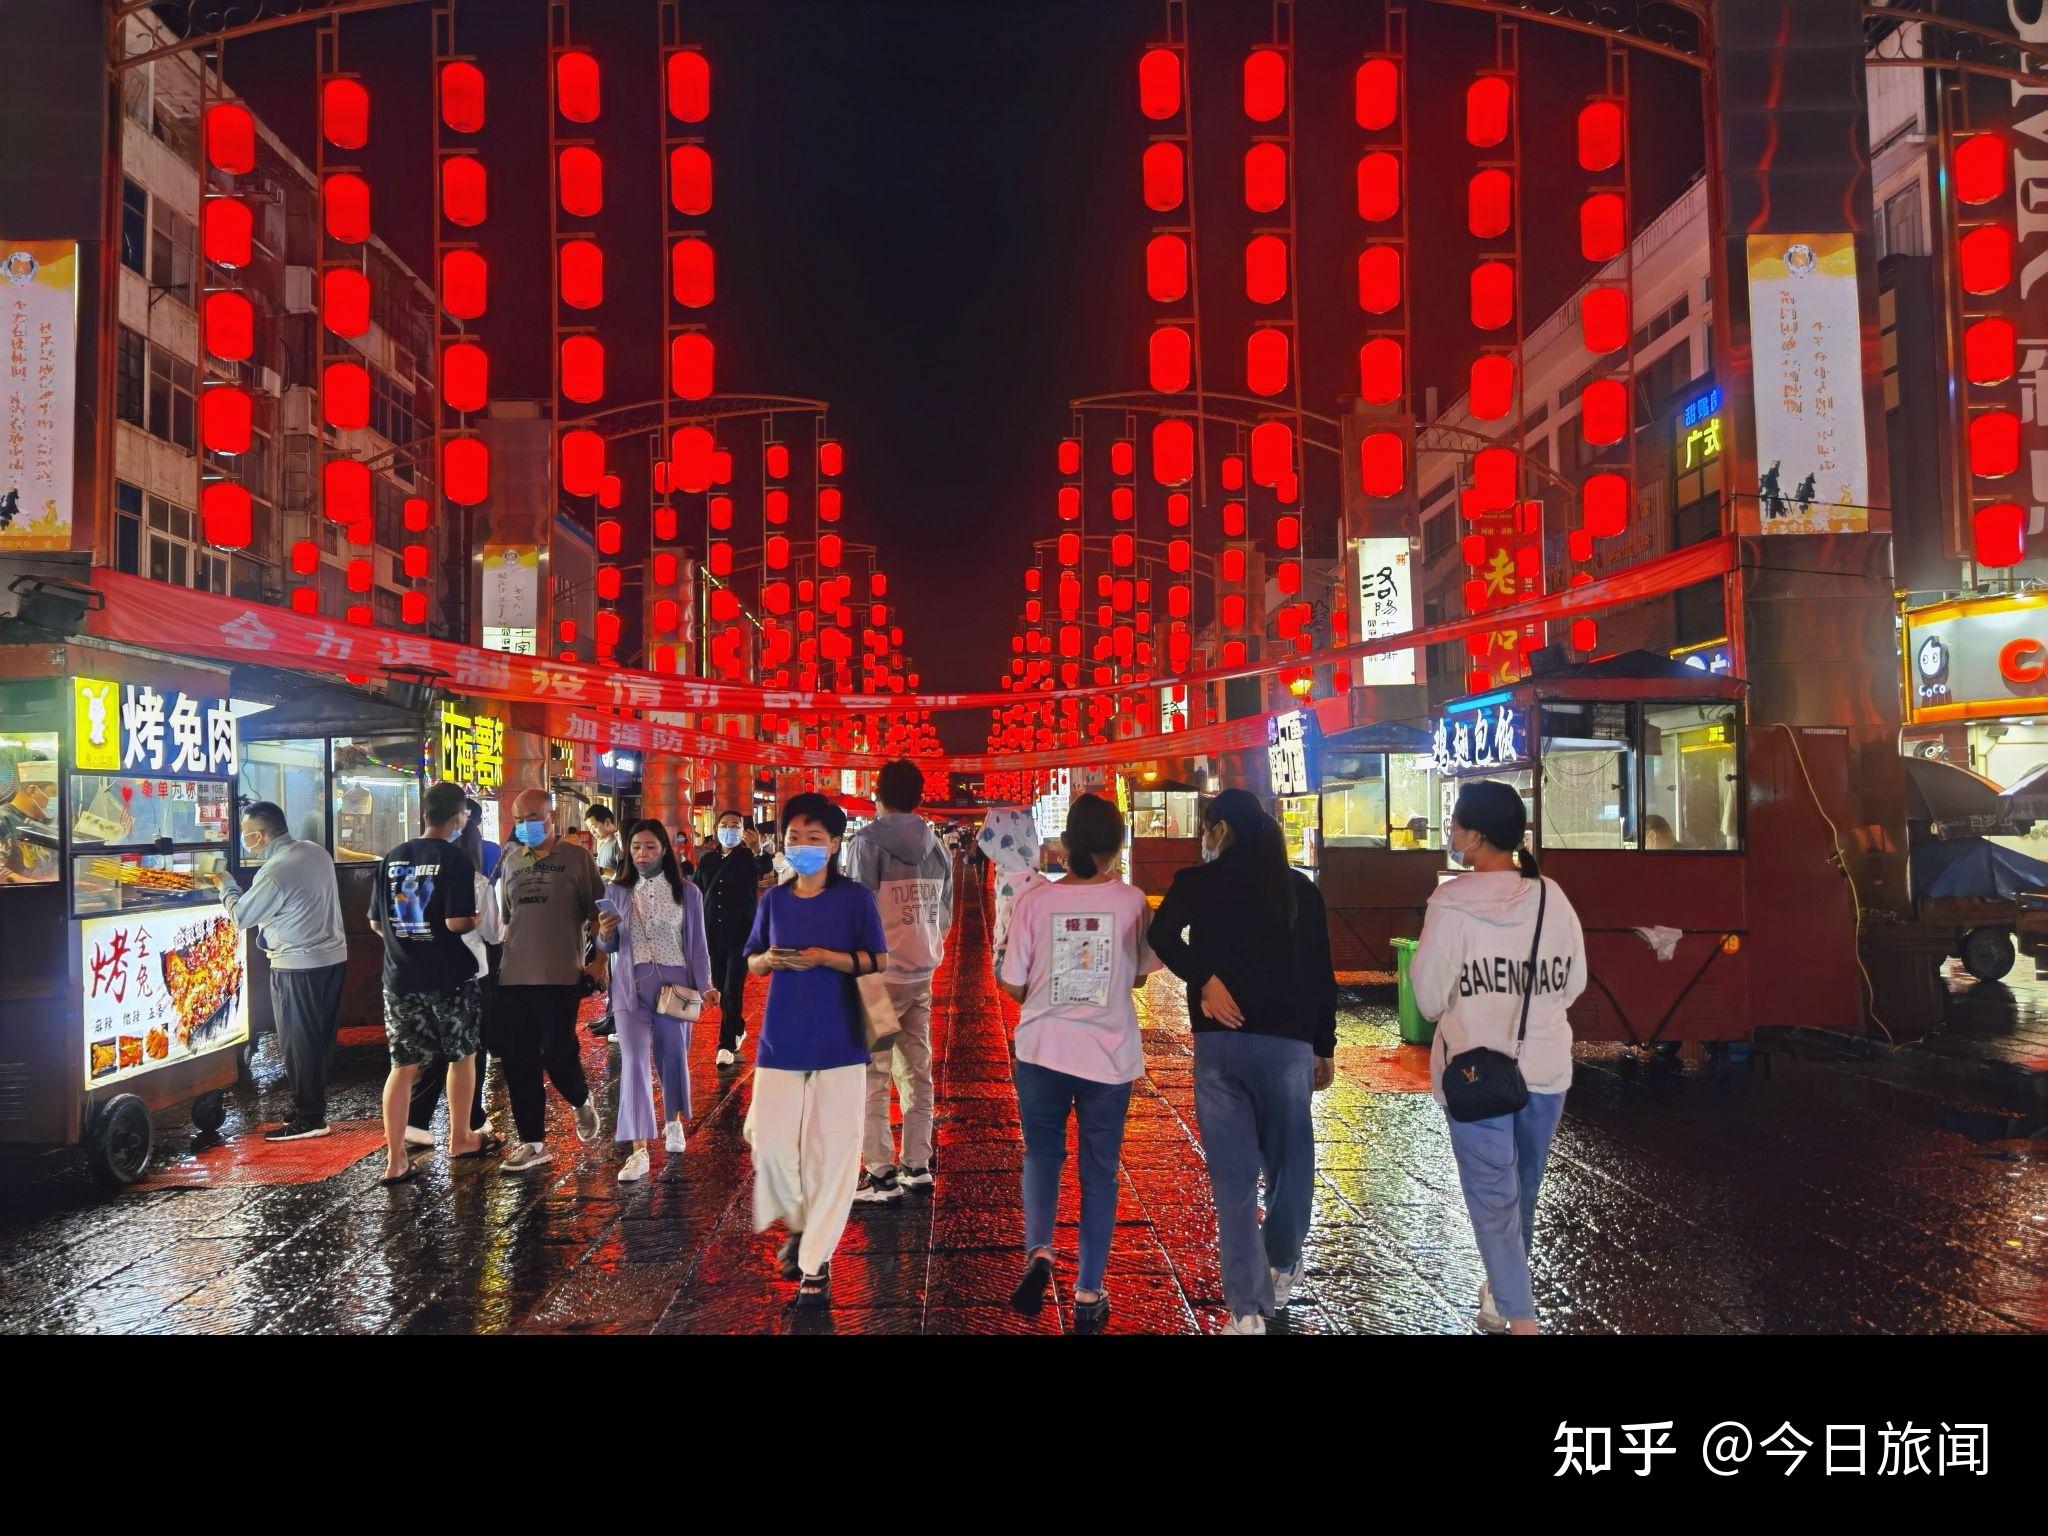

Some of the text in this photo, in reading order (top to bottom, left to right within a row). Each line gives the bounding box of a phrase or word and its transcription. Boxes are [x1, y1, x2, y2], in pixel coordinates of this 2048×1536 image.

[1685, 417, 1721, 468] 广式
[1998, 637, 2048, 684] C
[122, 684, 239, 775] 烤兔肉
[91, 927, 131, 1003] 烤
